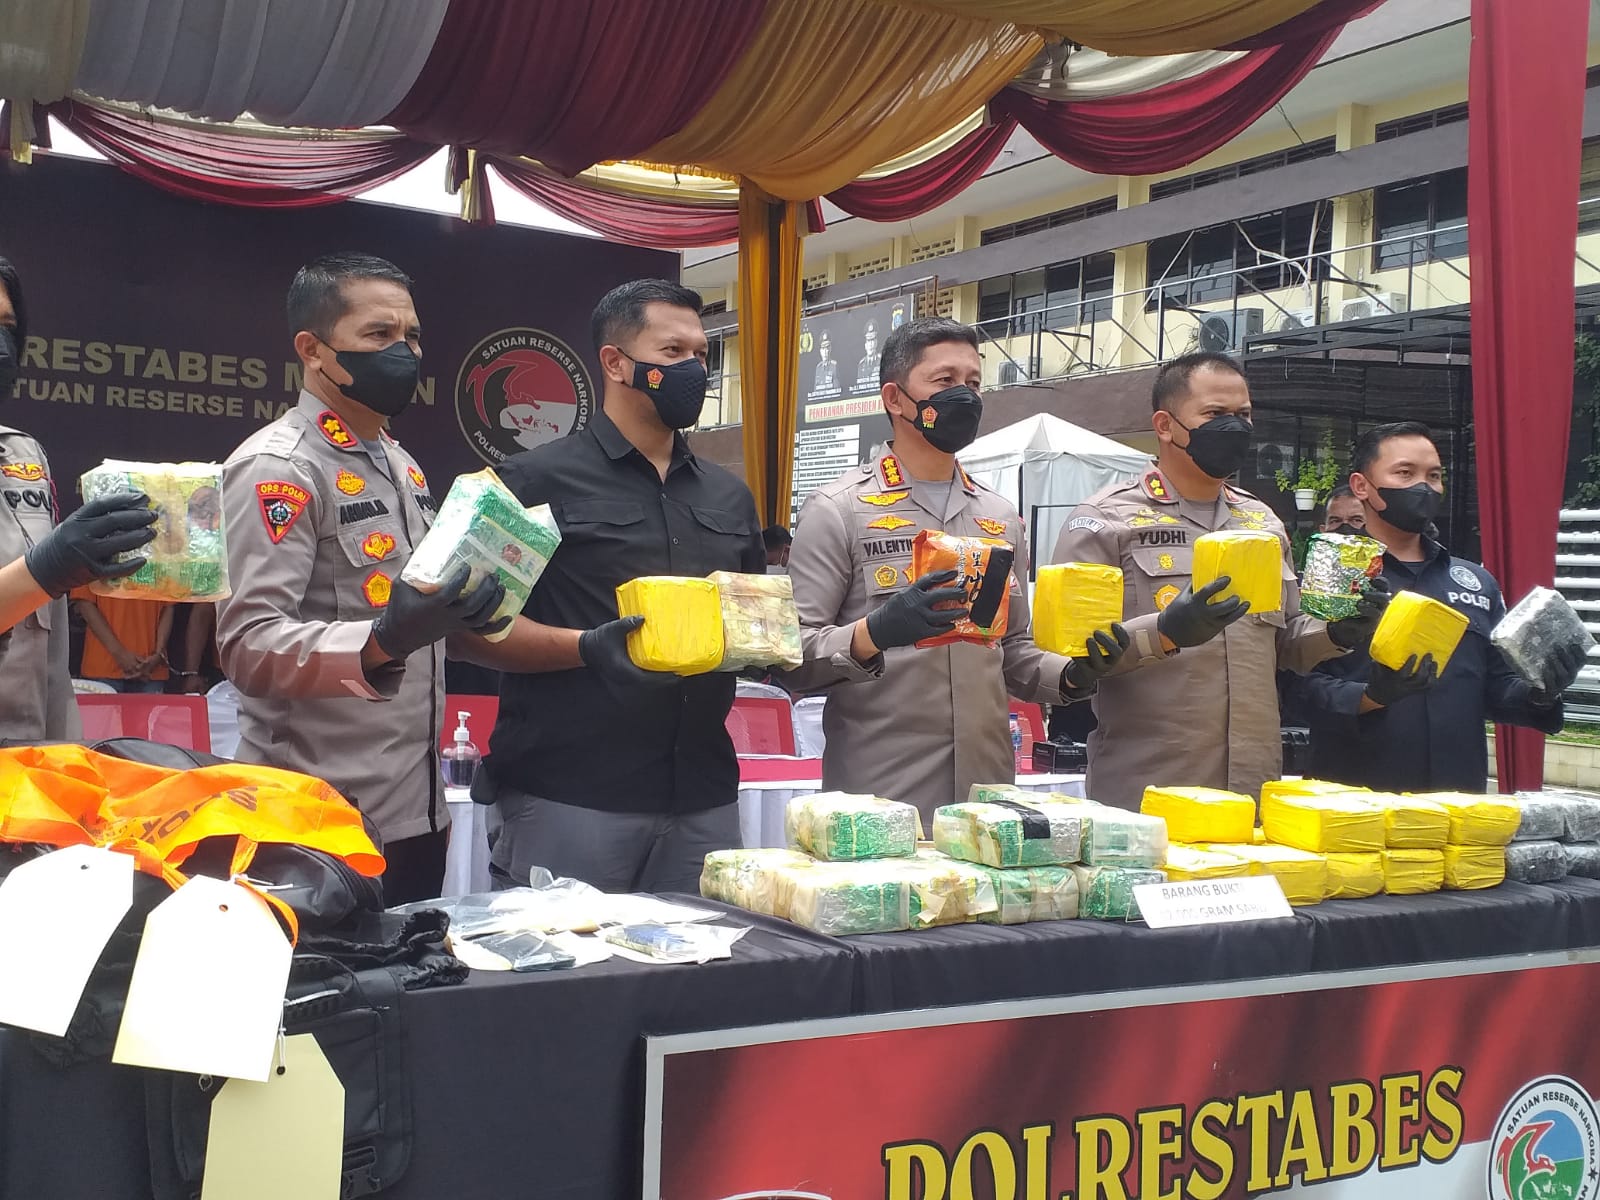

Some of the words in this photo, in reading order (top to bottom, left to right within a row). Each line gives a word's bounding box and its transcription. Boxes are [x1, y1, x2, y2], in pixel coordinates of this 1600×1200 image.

[481, 336, 526, 360] SATUAN
[529, 337, 577, 373] RESERSE
[573, 373, 588, 432] NARKOBA
[106, 387, 244, 418] RESERSE
[260, 484, 279, 493] OPS
[1138, 530, 1187, 545] YUDHI
[1161, 884, 1211, 900] BARANG
[1211, 882, 1243, 896] BUKT
[881, 1067, 1465, 1200] POLRESTABES
[1506, 1094, 1540, 1134] SATUAN
[1542, 1091, 1579, 1112] RESERSE
[1578, 1108, 1596, 1165] NARKOBA
